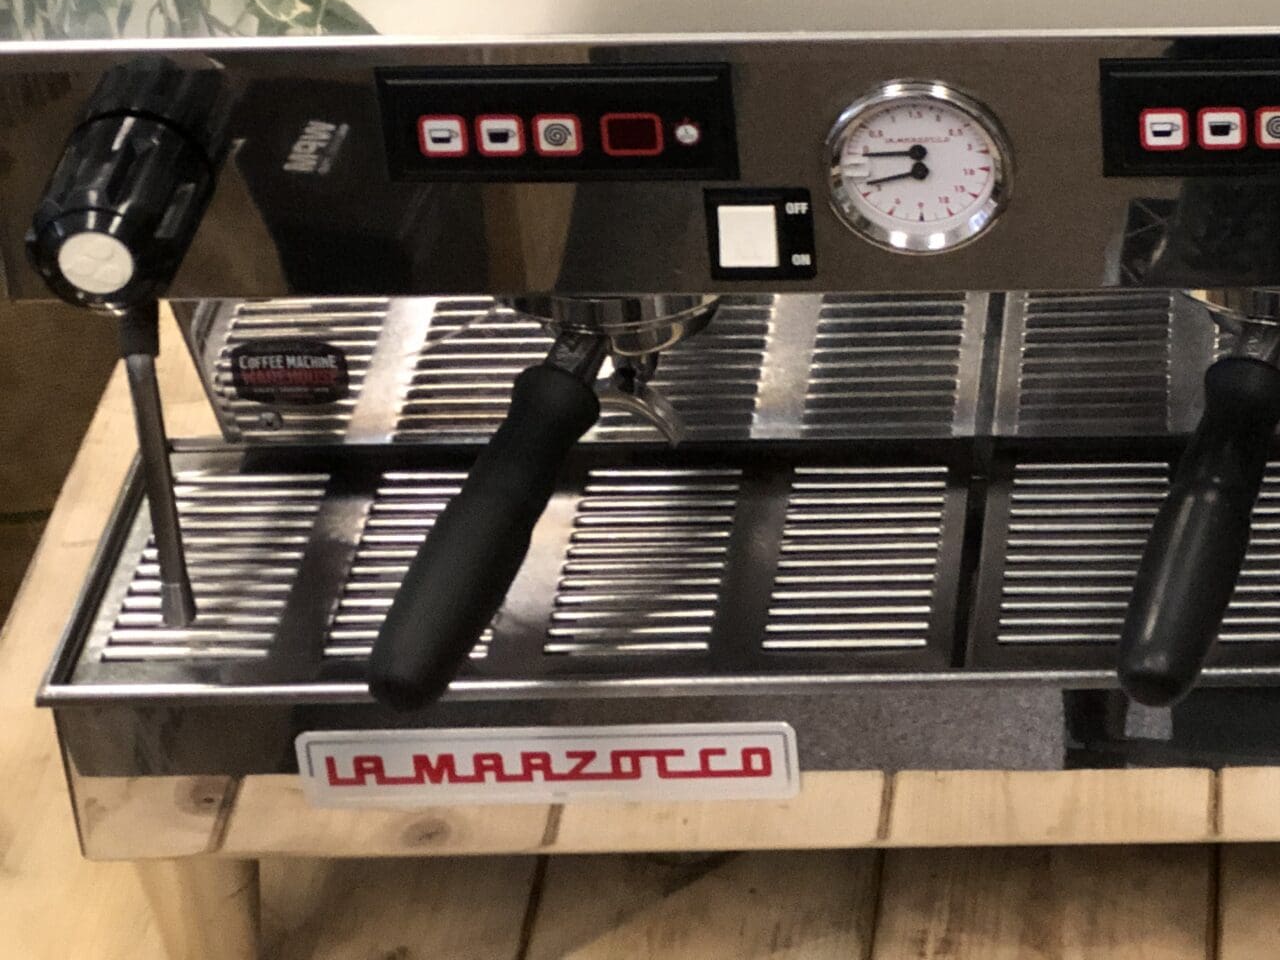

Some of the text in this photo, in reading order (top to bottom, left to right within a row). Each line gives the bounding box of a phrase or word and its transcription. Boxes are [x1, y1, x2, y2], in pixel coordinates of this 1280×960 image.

[785, 202, 809, 215] OFF
[791, 253, 811, 266] ON
[239, 353, 337, 370] COFFEE MACHINE
[325, 746, 774, 787] LA MARZOCCO
